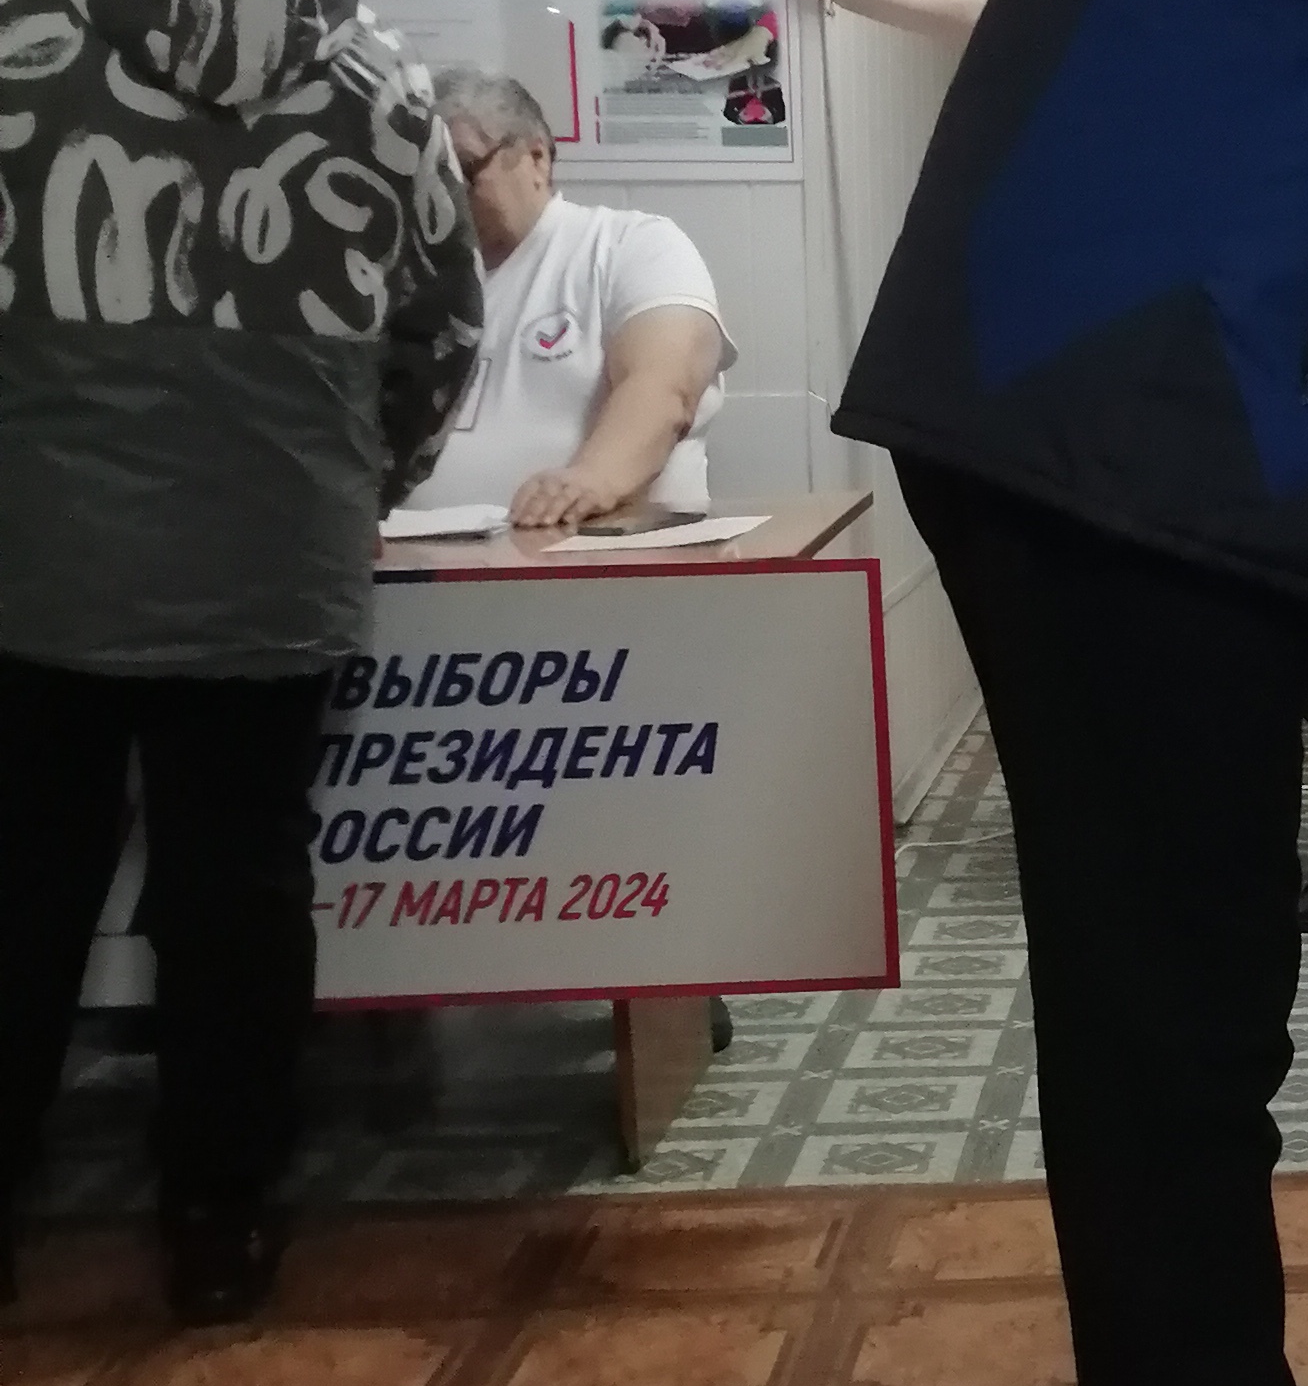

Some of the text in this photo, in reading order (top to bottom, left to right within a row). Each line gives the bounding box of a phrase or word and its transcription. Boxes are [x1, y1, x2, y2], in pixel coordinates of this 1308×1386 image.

[331, 649, 629, 710] ВЫБОРЫ
[311, 722, 718, 789] ПРЕЗИДЕНТА
[389, 877, 548, 927] МАРТА
[558, 871, 669, 922] 2024
